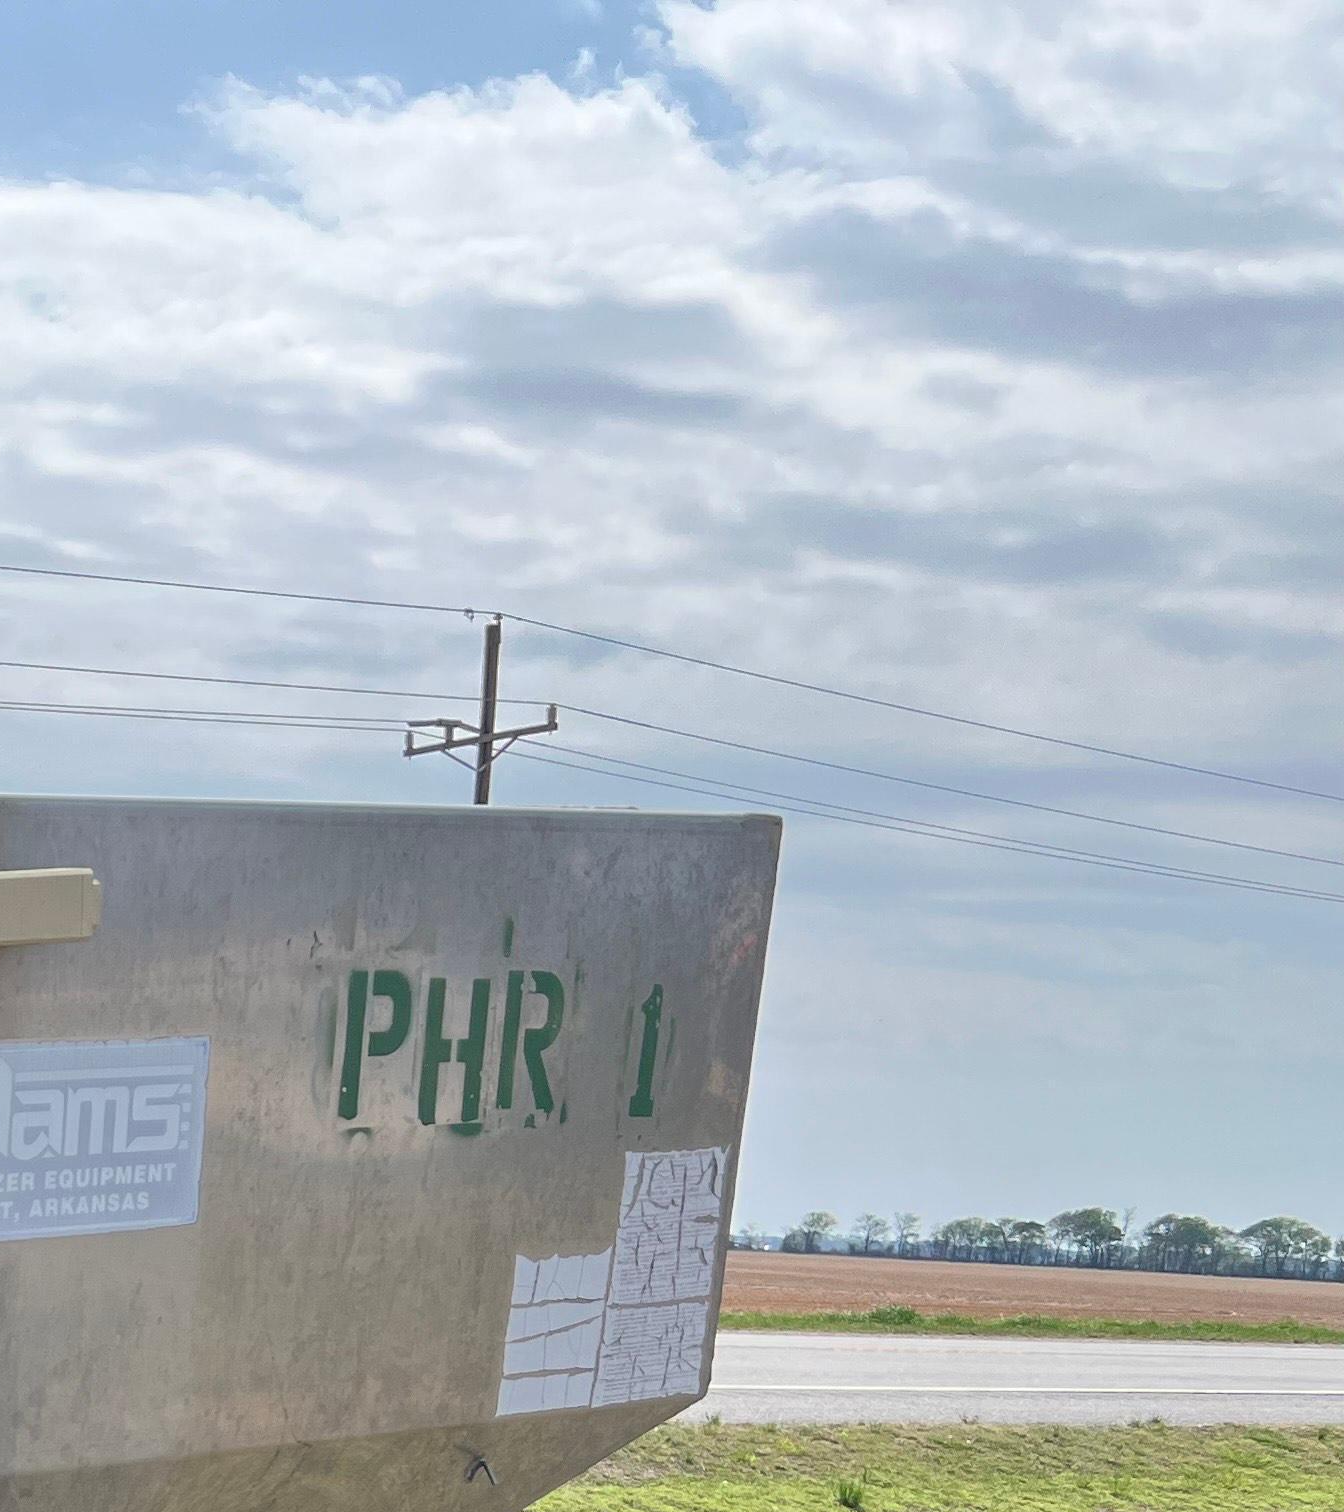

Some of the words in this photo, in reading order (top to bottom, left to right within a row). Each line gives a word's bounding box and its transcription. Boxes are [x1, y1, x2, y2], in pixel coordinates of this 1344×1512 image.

[338, 970, 565, 1125] PHR
[629, 984, 664, 1117] 1
[44, 1162, 177, 1190] EQUIPMENT
[29, 1191, 150, 1219] ARKANSAS
